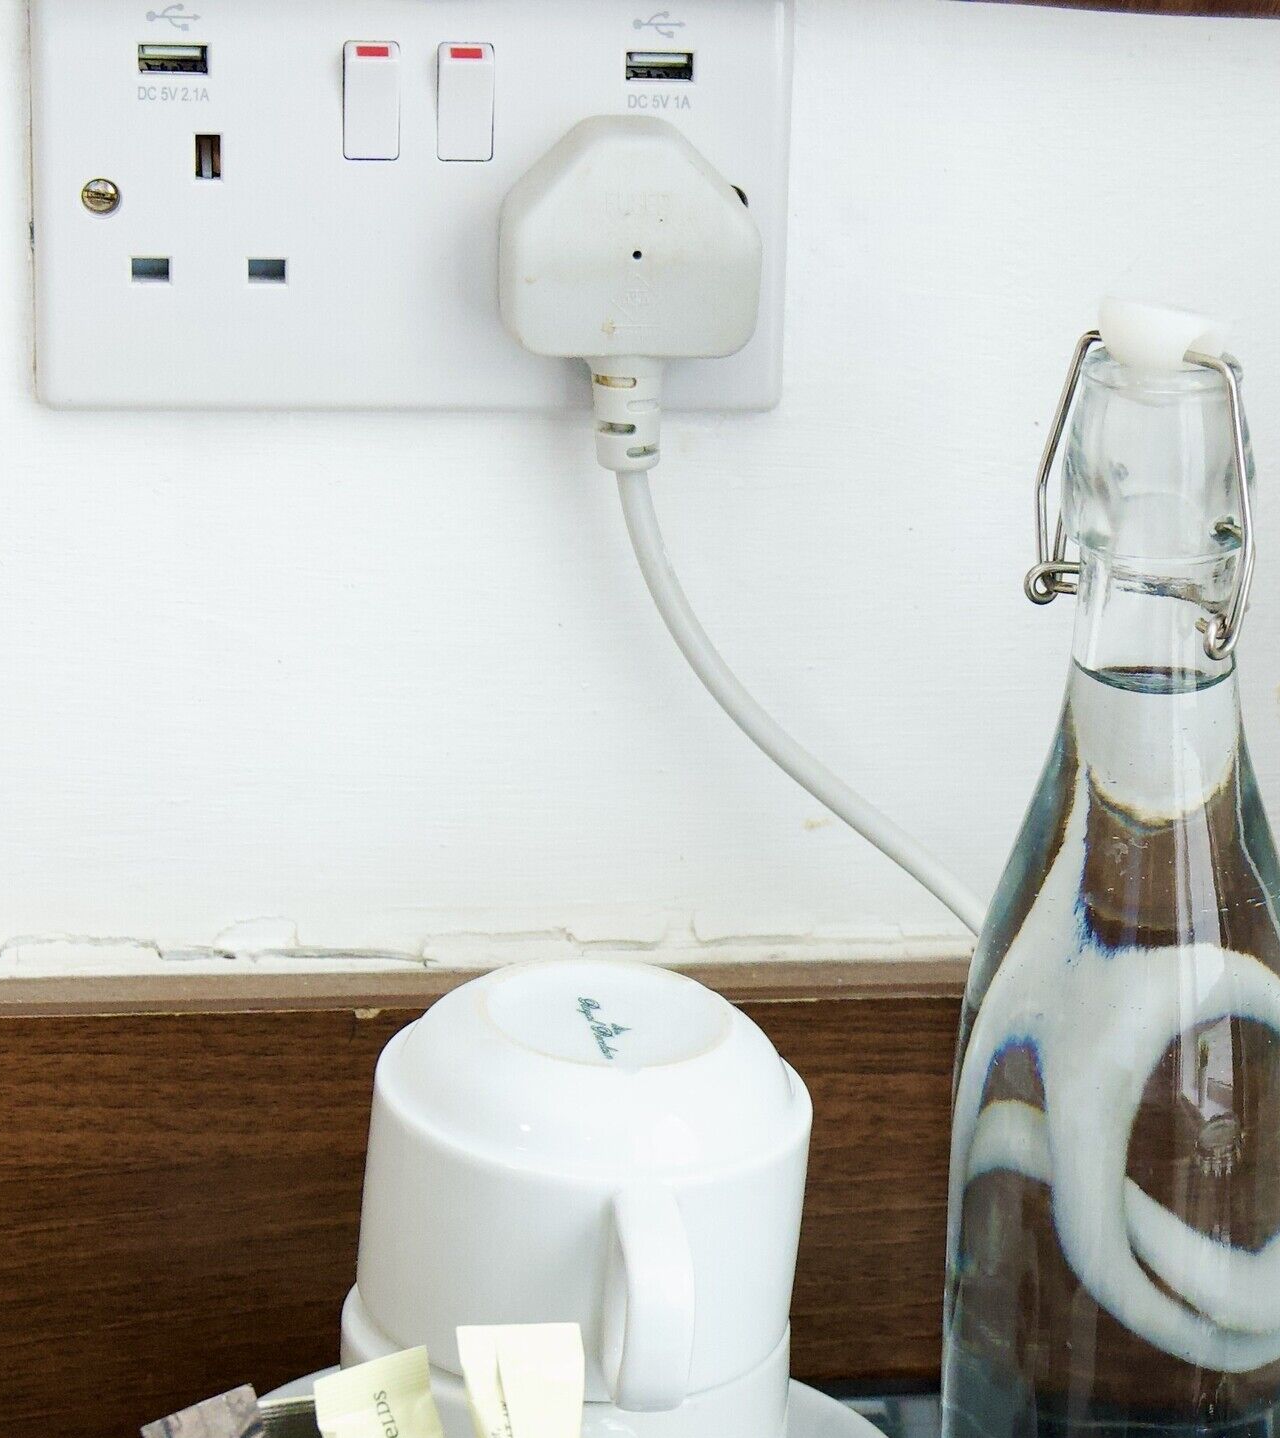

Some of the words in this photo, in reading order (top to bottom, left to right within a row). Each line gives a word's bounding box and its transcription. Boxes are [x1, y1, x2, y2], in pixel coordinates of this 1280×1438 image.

[137, 86, 157, 101] DC
[160, 86, 178, 101] 5V
[181, 87, 210, 102] 2.1A
[627, 94, 648, 109] DC
[652, 94, 670, 109] 5V
[674, 94, 692, 109] 1A
